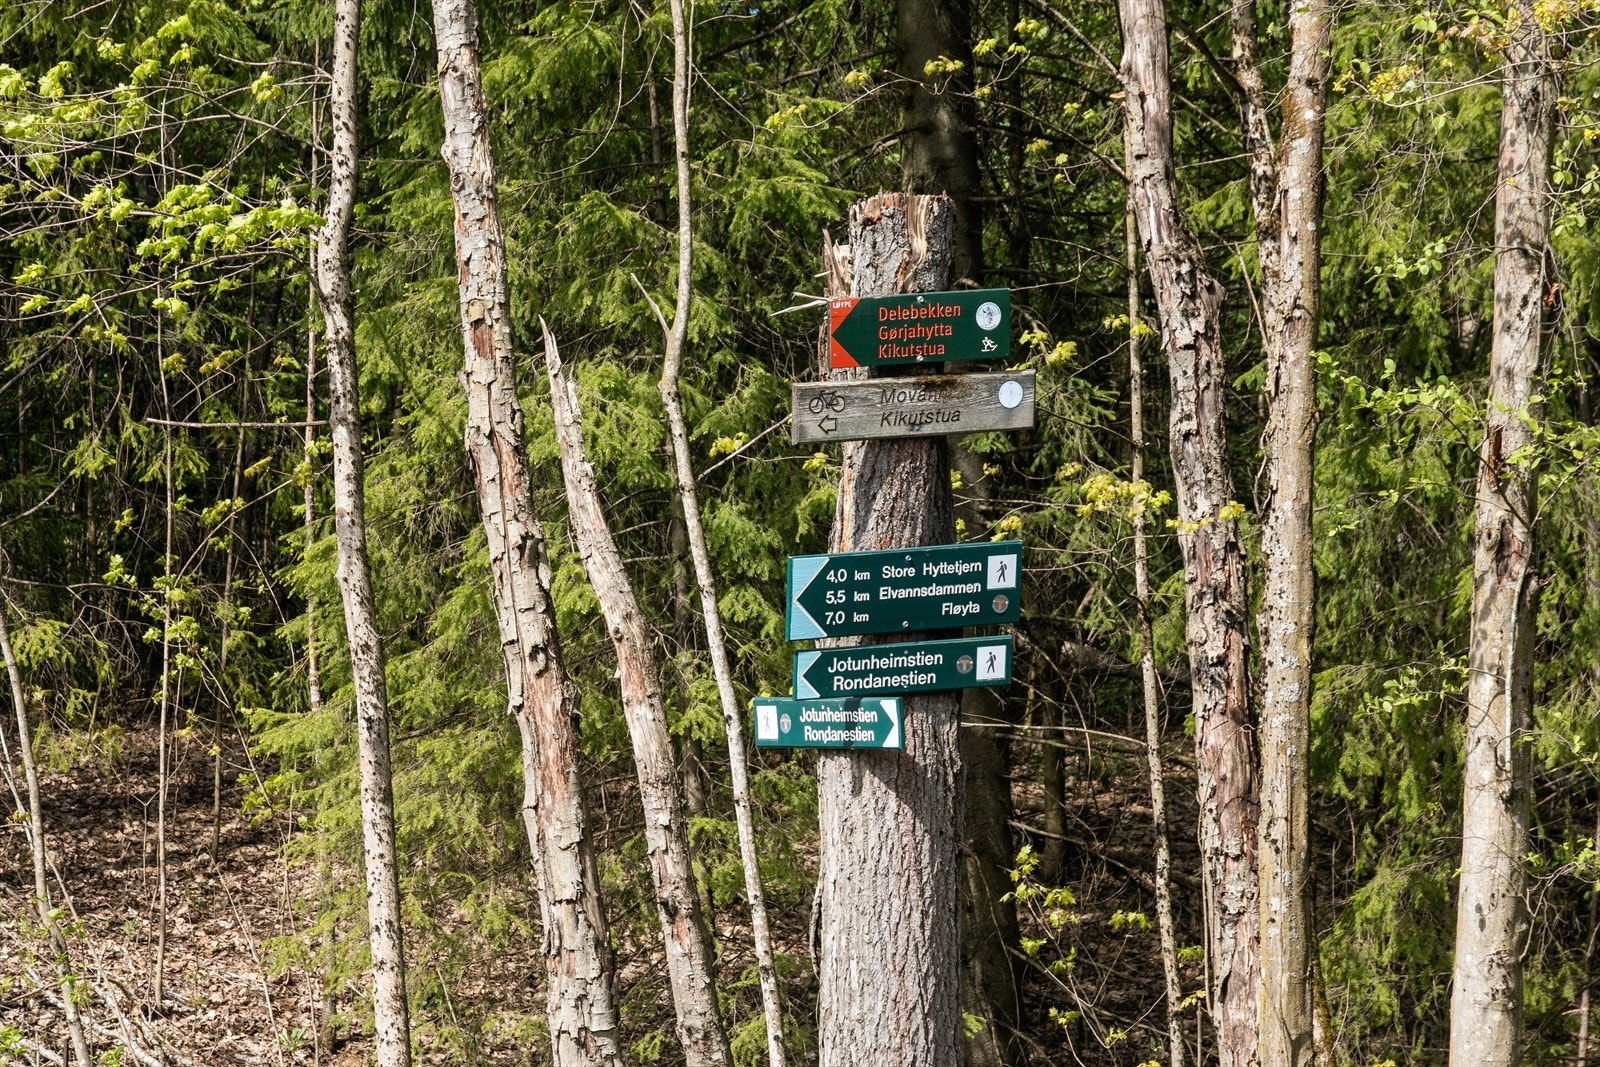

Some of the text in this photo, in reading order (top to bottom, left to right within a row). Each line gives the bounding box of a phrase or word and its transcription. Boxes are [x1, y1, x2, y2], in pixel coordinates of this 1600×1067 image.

[832, 300, 852, 309] LØYPE
[878, 302, 961, 322] Delebekken
[878, 323, 953, 342] Gørjahytta
[877, 343, 945, 359] Kikutstua
[880, 409, 961, 427] Kikutstua
[826, 560, 982, 584] 4,0 km Store Hyttetjern
[825, 582, 982, 605] 5,5 km Elvannsdammen
[824, 602, 981, 626] 7,0 km Fløyta
[828, 652, 944, 673] Jotunheimstien
[833, 671, 937, 691] Rondanestien
[799, 706, 878, 723] Jotunheimstien
[804, 726, 875, 743] Rondanestien
